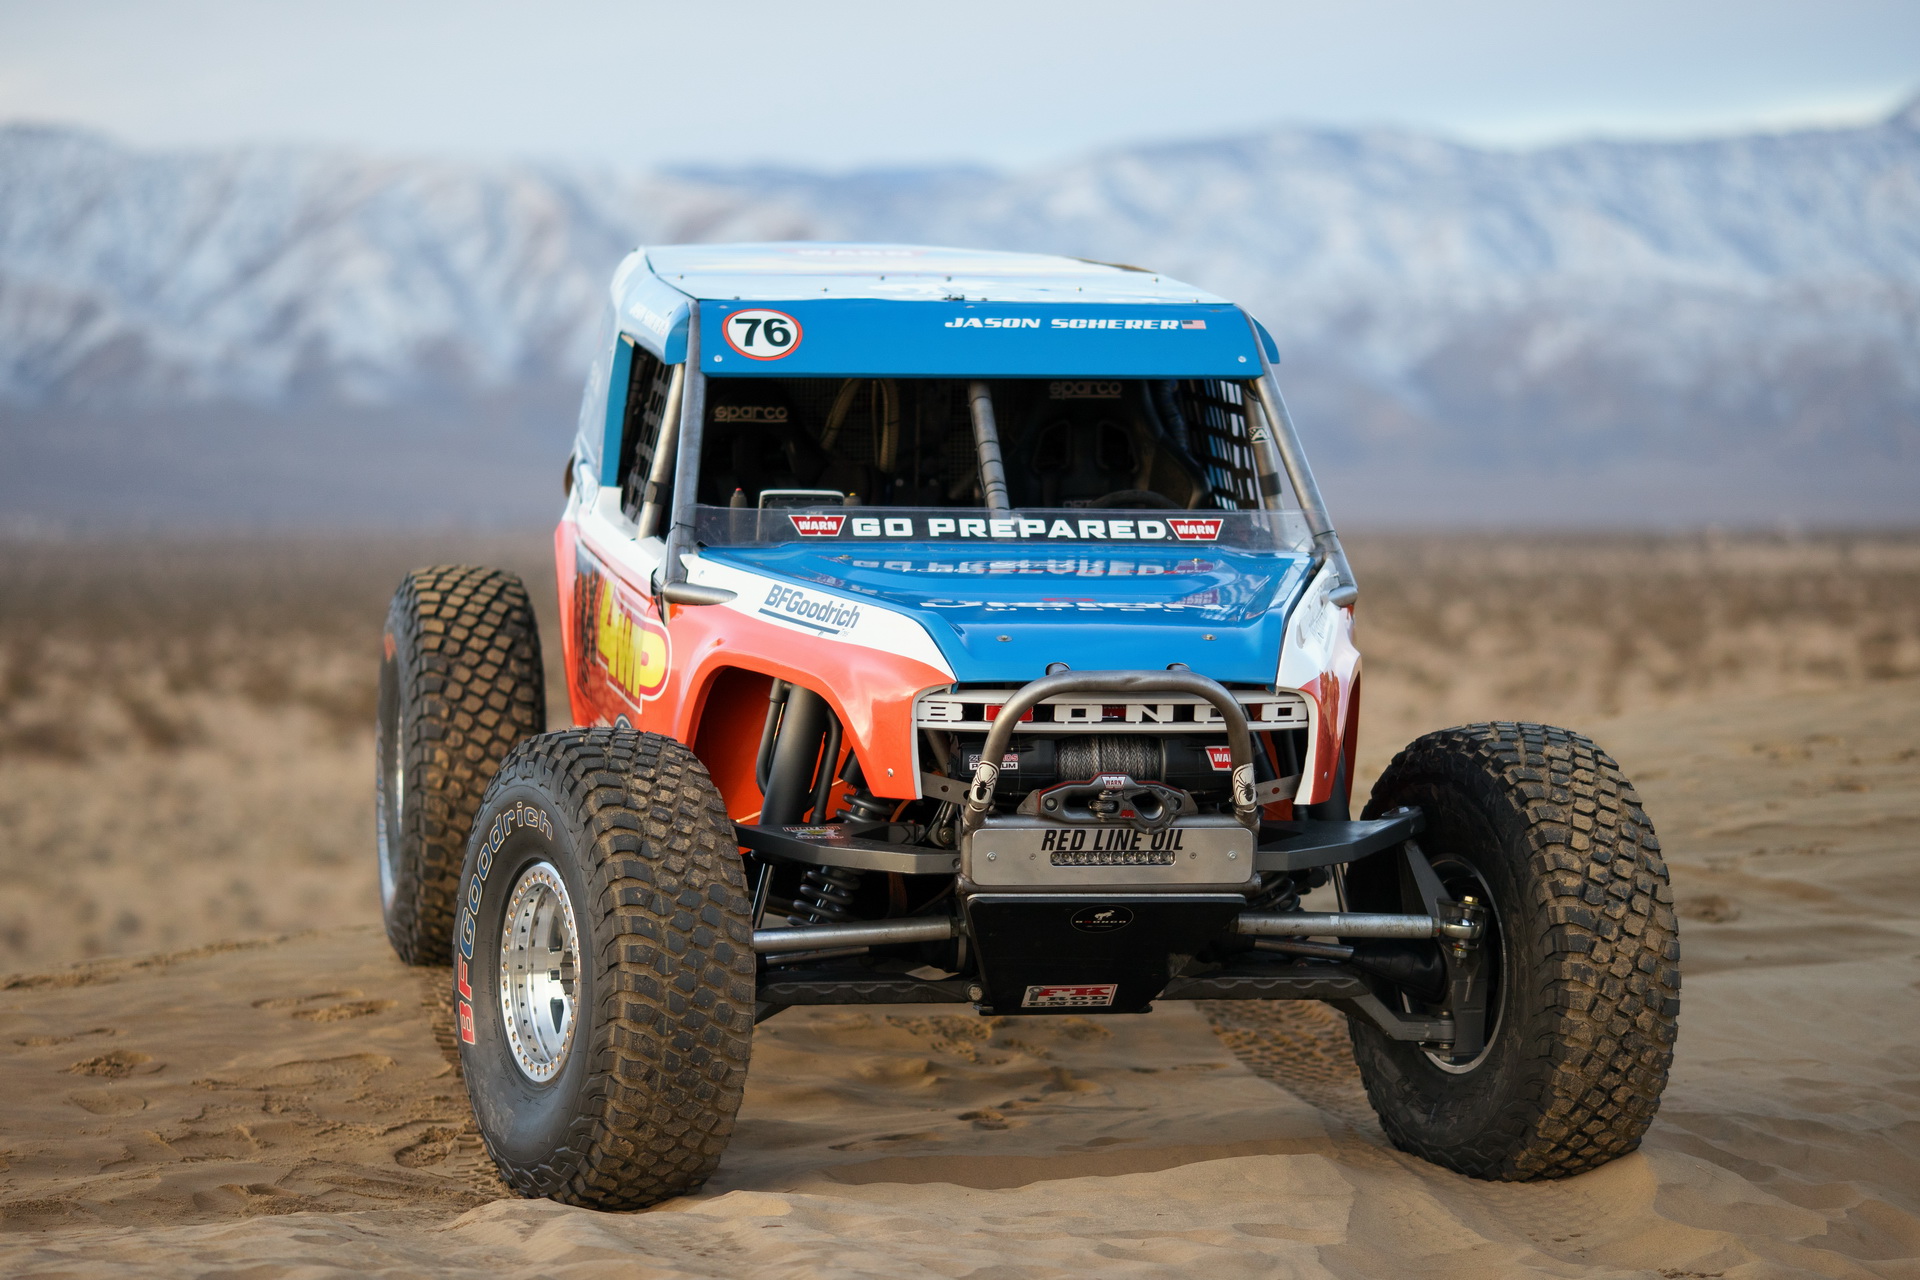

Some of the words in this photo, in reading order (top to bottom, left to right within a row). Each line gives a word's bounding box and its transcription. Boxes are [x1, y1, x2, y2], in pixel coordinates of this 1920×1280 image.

[735, 318, 792, 347] 76
[944, 317, 1041, 328] JASON
[1051, 318, 1179, 330] SCHERER
[1049, 381, 1122, 400] sparco
[714, 406, 788, 423] sparco
[798, 520, 837, 531] WARN
[852, 517, 914, 537] GO
[1176, 524, 1215, 535] WARN
[764, 584, 861, 629] BFGoodrich
[1041, 829, 1087, 851] RED
[1093, 829, 1142, 851] LINE
[1150, 829, 1185, 851] OIL
[458, 801, 553, 1045] BFGoodrich
[1038, 986, 1111, 997] FK
